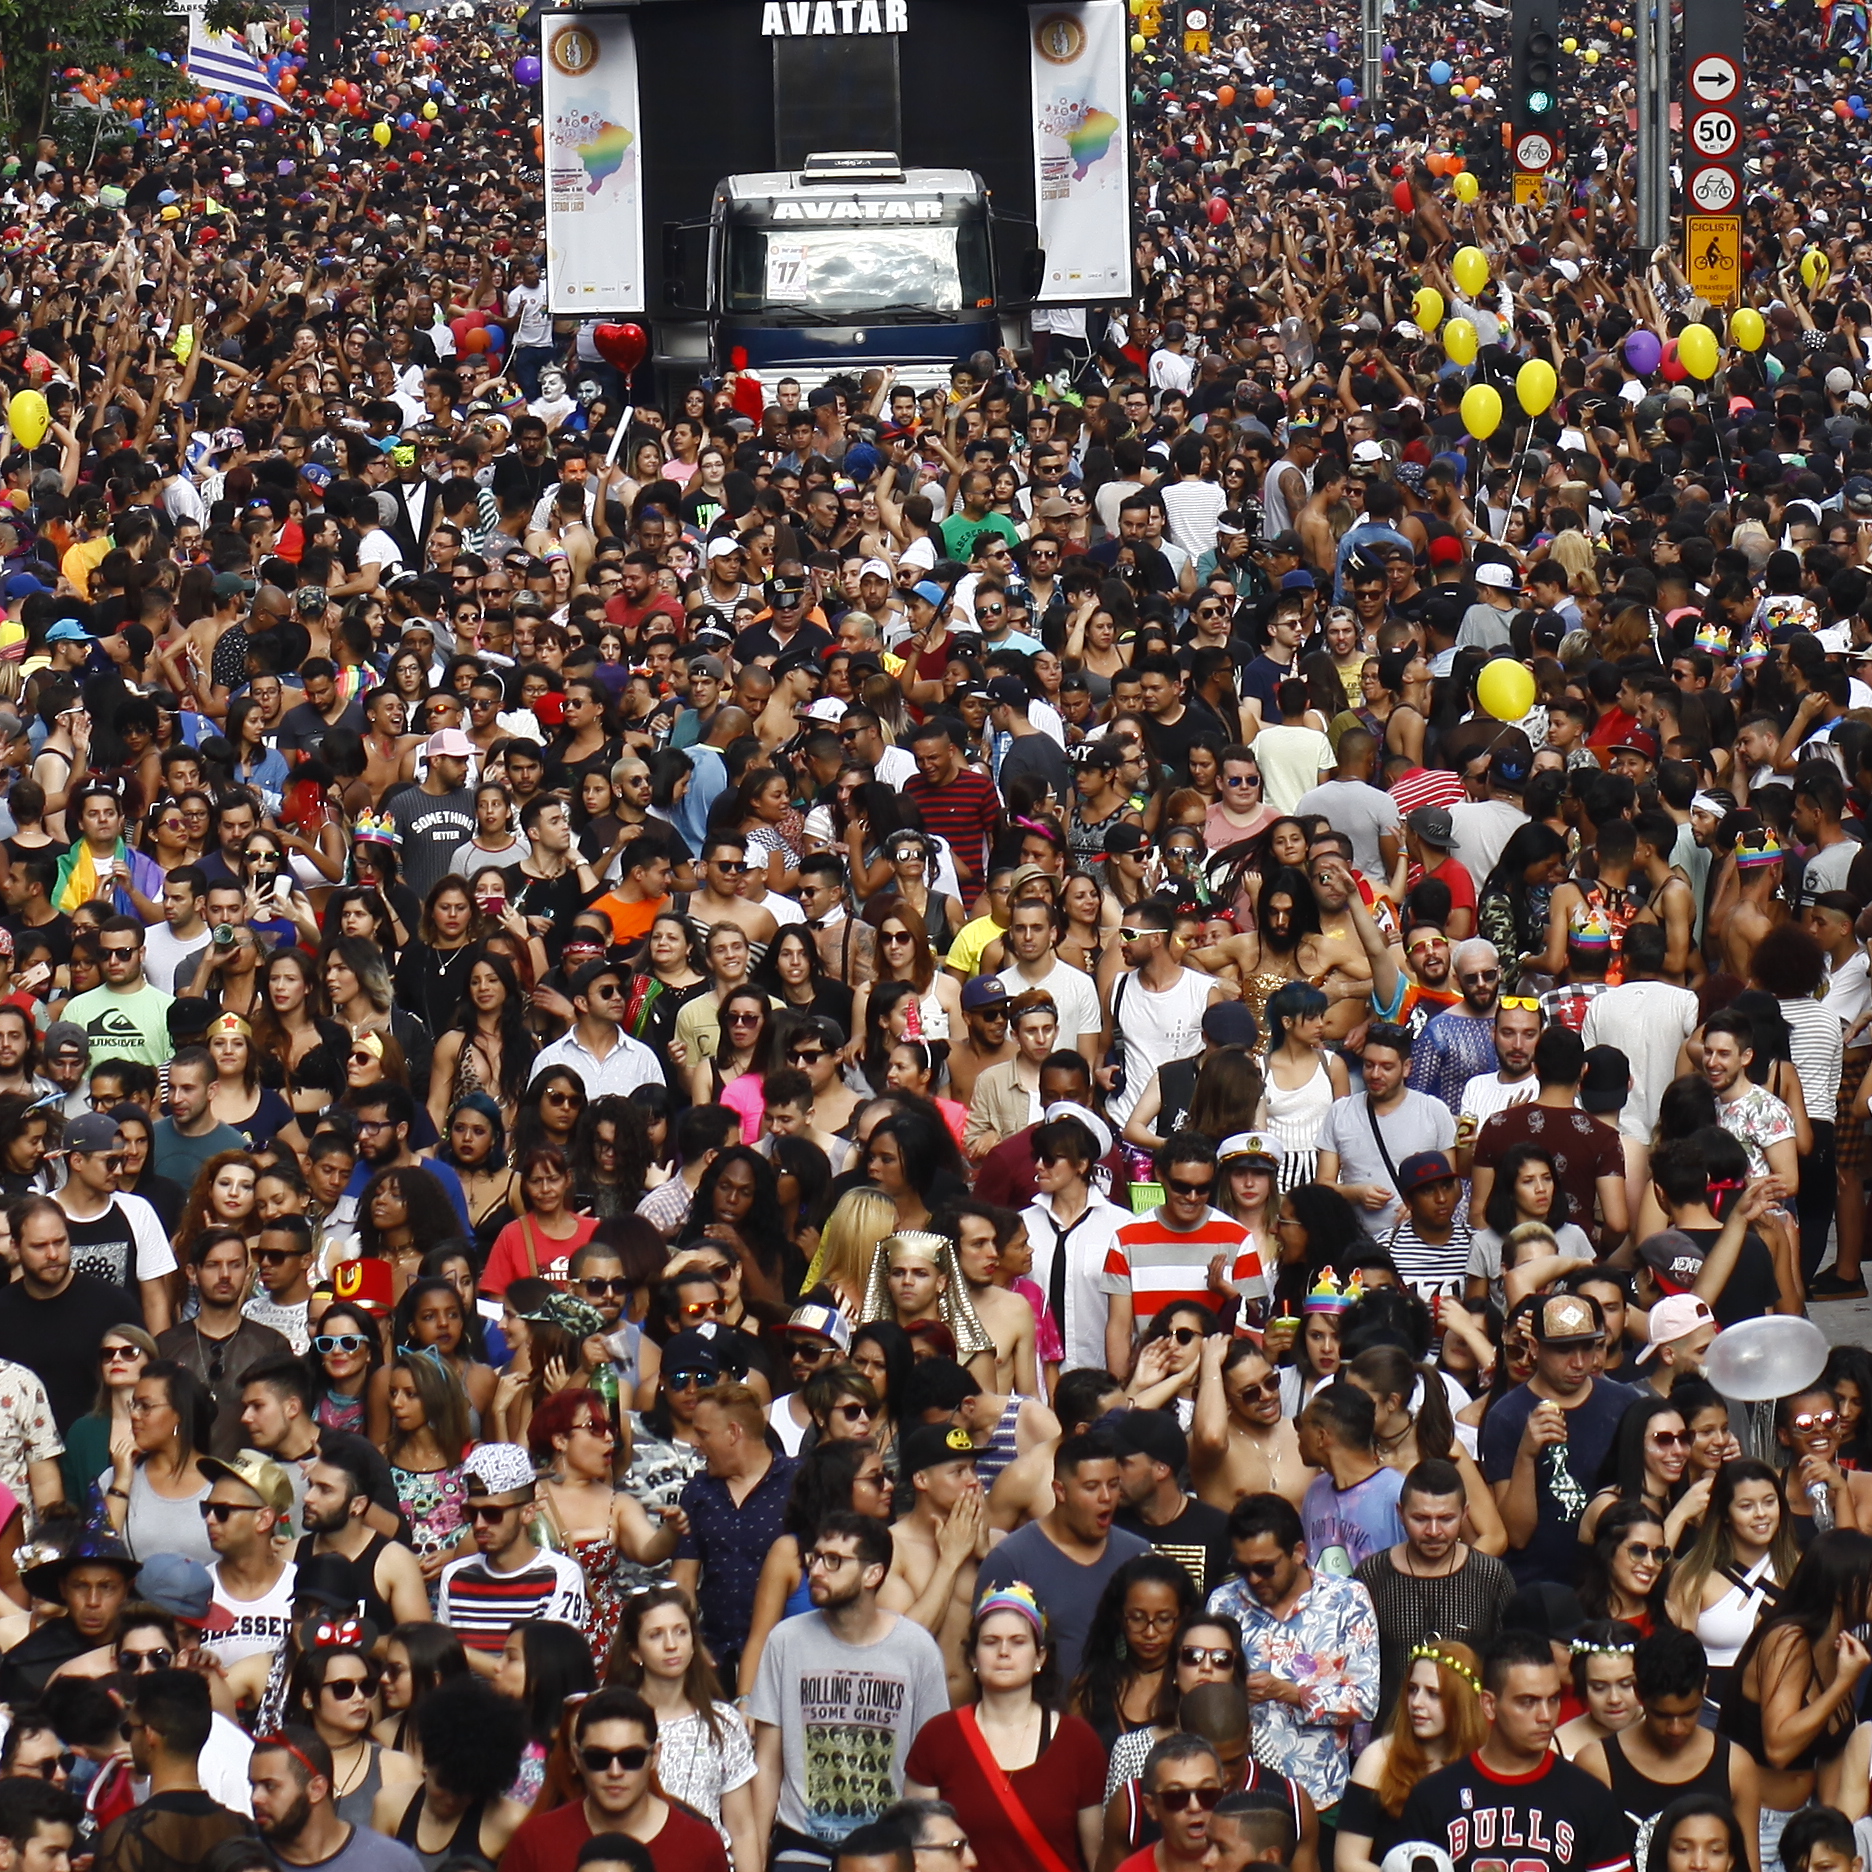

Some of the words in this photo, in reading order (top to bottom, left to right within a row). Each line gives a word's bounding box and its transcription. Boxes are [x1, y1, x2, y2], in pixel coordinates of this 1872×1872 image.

[1698, 119, 1732, 142] 50
[771, 199, 944, 220] AVATAR
[1690, 221, 1735, 233] CICLISTA
[778, 260, 801, 285] 17
[410, 806, 475, 835] SOMETHING
[432, 830, 461, 841] BETTER
[558, 1590, 583, 1622] 78
[800, 1676, 852, 1707] ROLLING
[857, 1678, 906, 1713] STONES
[1446, 1806, 1576, 1865] BULLS
